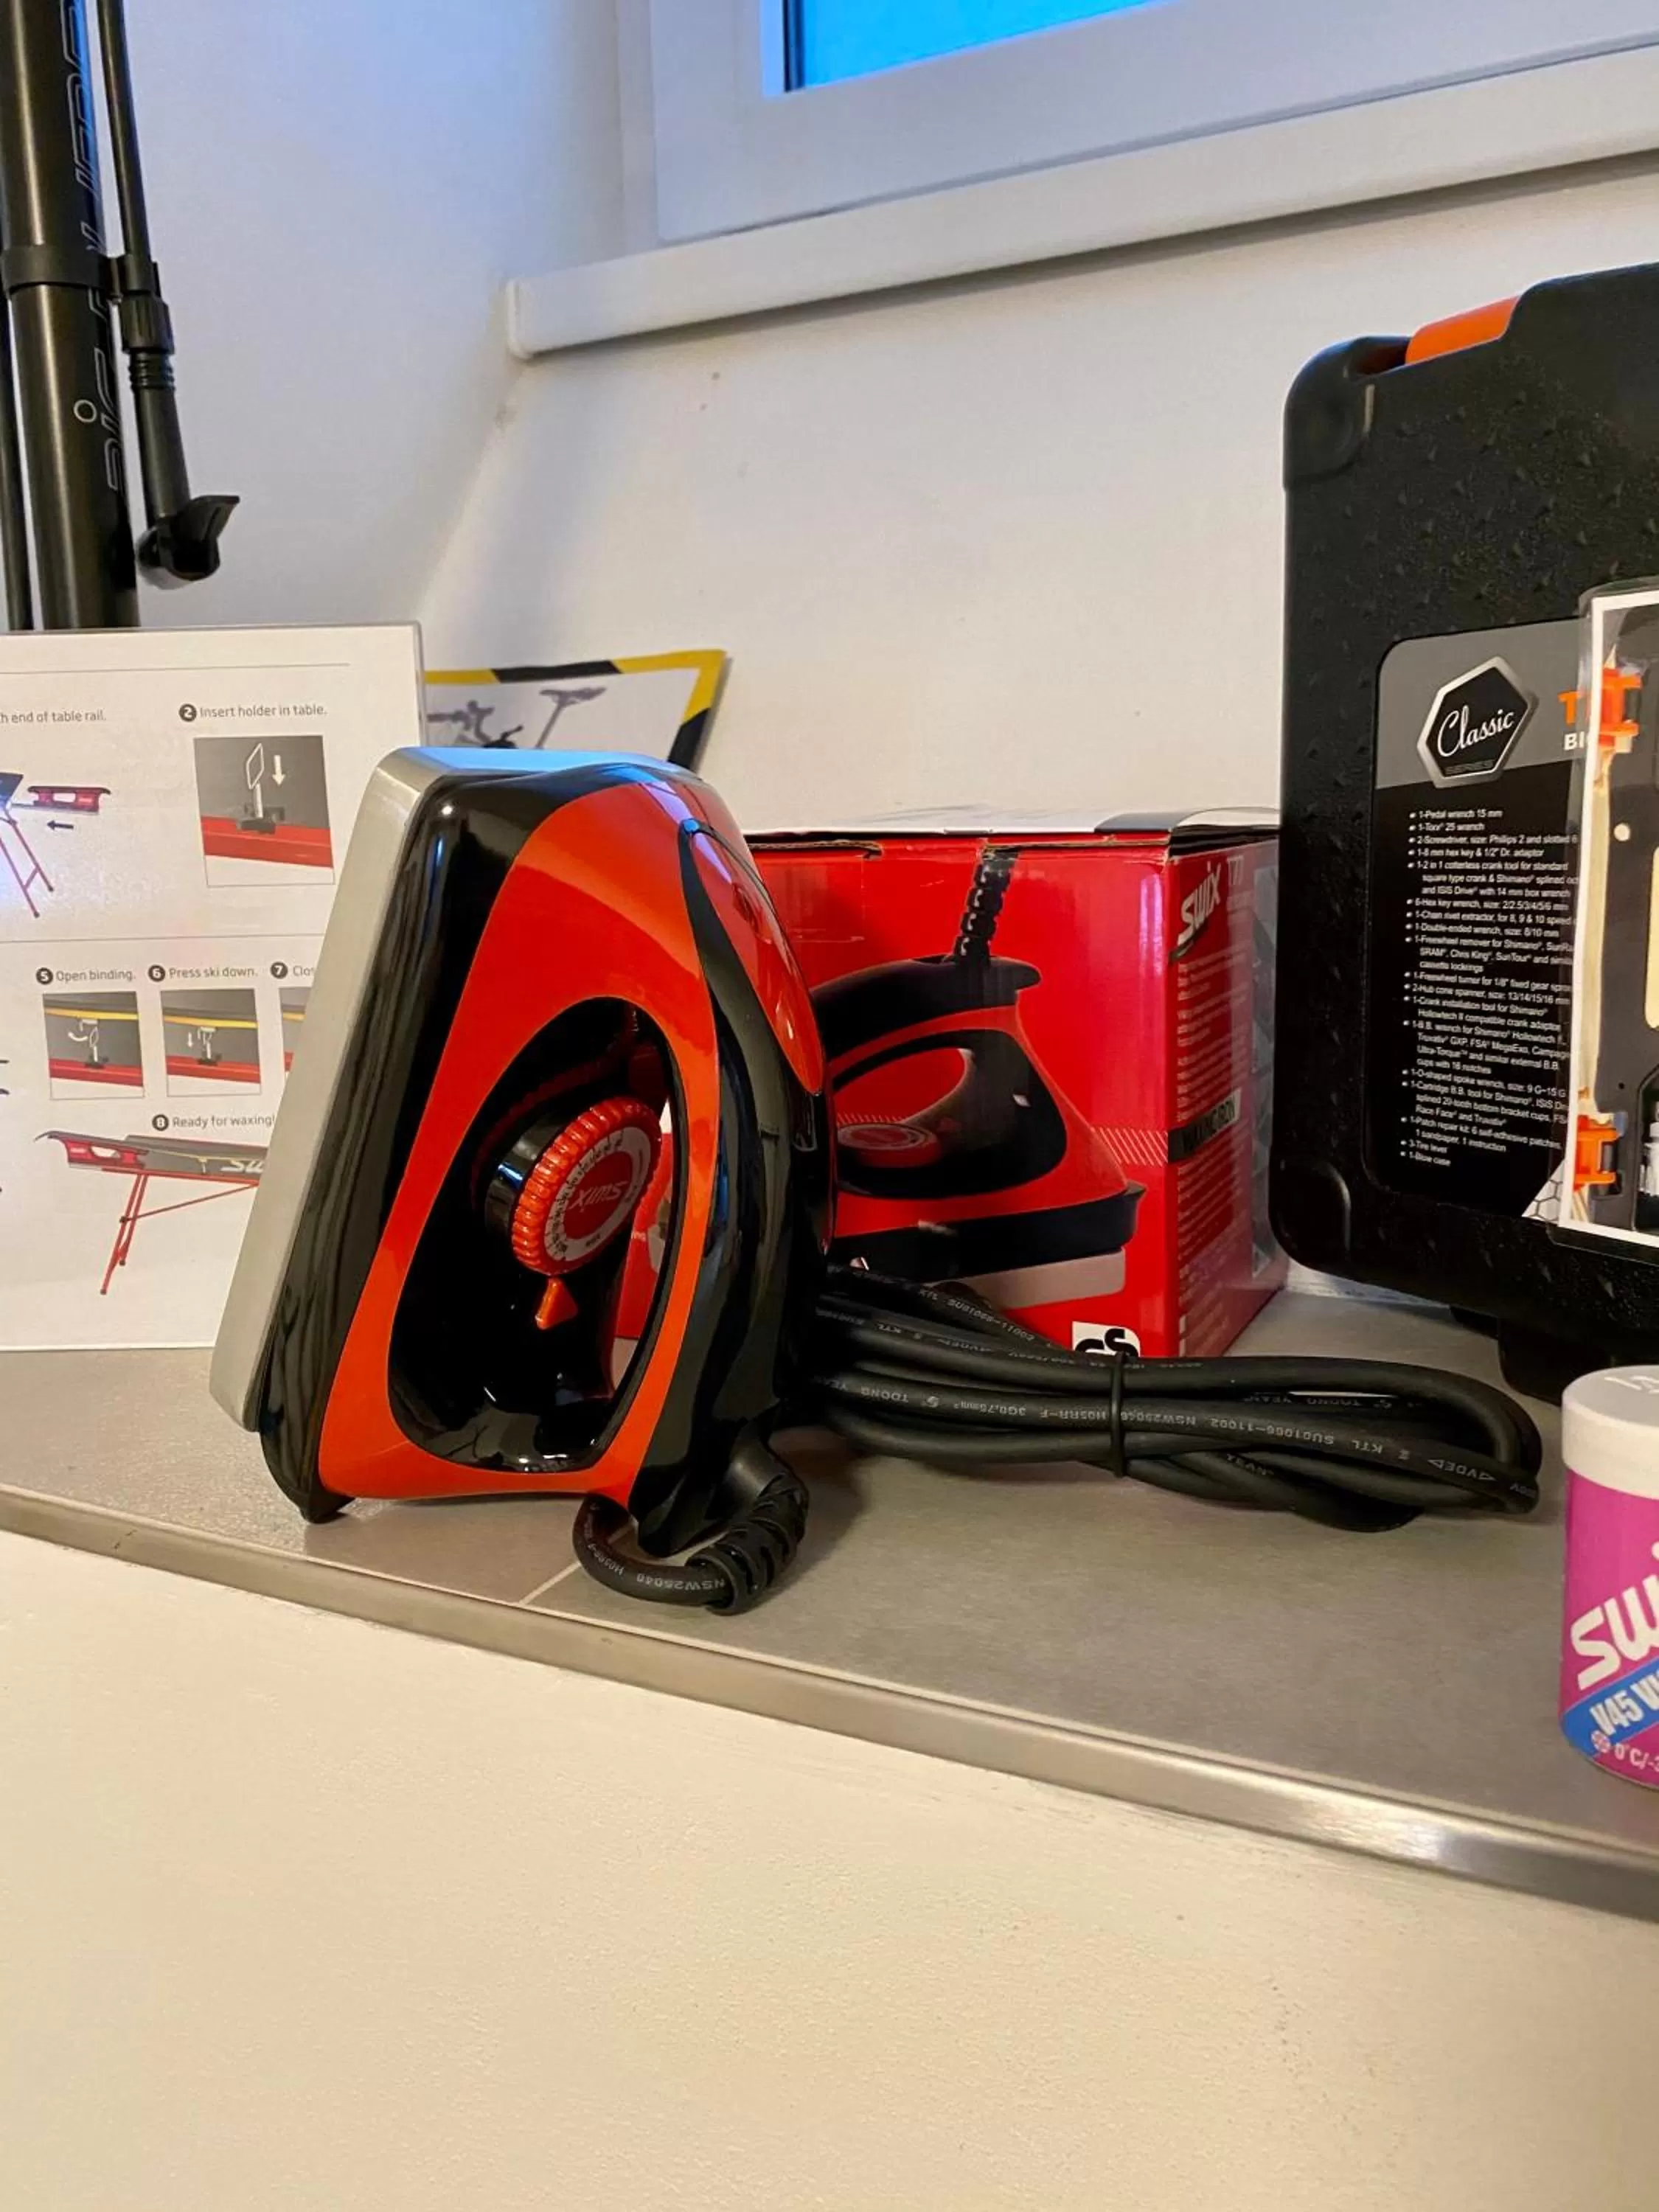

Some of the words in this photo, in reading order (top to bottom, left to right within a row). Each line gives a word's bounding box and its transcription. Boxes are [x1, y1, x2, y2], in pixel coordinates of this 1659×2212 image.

[11, 712, 34, 723] end
[36, 711, 48, 723] of
[52, 710, 83, 722] table
[85, 709, 106, 720] rail.
[200, 706, 236, 717] Insert
[238, 705, 276, 717] holder
[280, 704, 291, 715] in
[293, 703, 327, 715] table.
[1439, 705, 1514, 757] Classic
[55, 970, 86, 984] Open
[89, 969, 136, 981] binding.
[169, 967, 201, 978] Press
[204, 967, 220, 977] ski
[222, 966, 258, 977] down.
[173, 1116, 209, 1129] Ready
[212, 1116, 227, 1125] for
[231, 1115, 276, 1127] waxing!
[1590, 1690, 1644, 1736] V45
